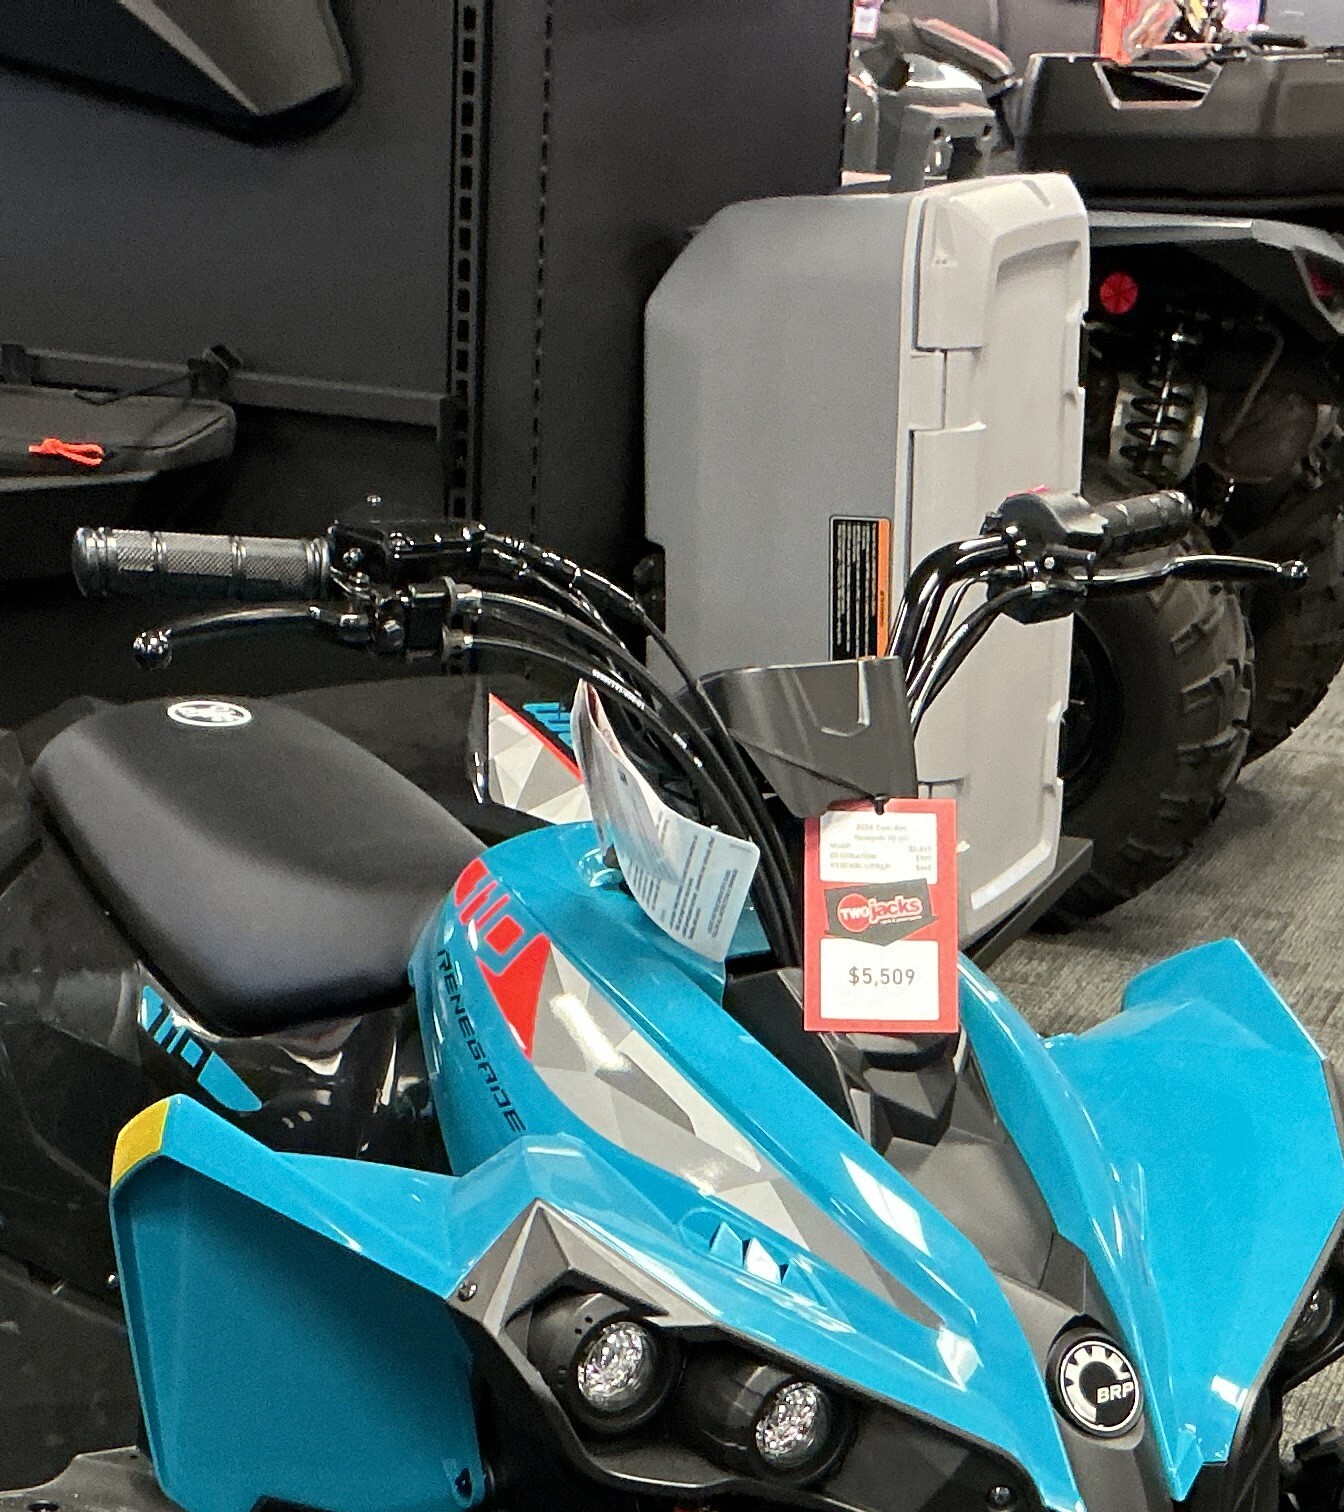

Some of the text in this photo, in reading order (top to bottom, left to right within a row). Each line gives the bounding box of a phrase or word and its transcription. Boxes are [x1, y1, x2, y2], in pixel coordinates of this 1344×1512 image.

[848, 966, 916, 987] $5,509
[437, 949, 527, 1133] RENEGADE
[1096, 1381, 1135, 1404] BRP
